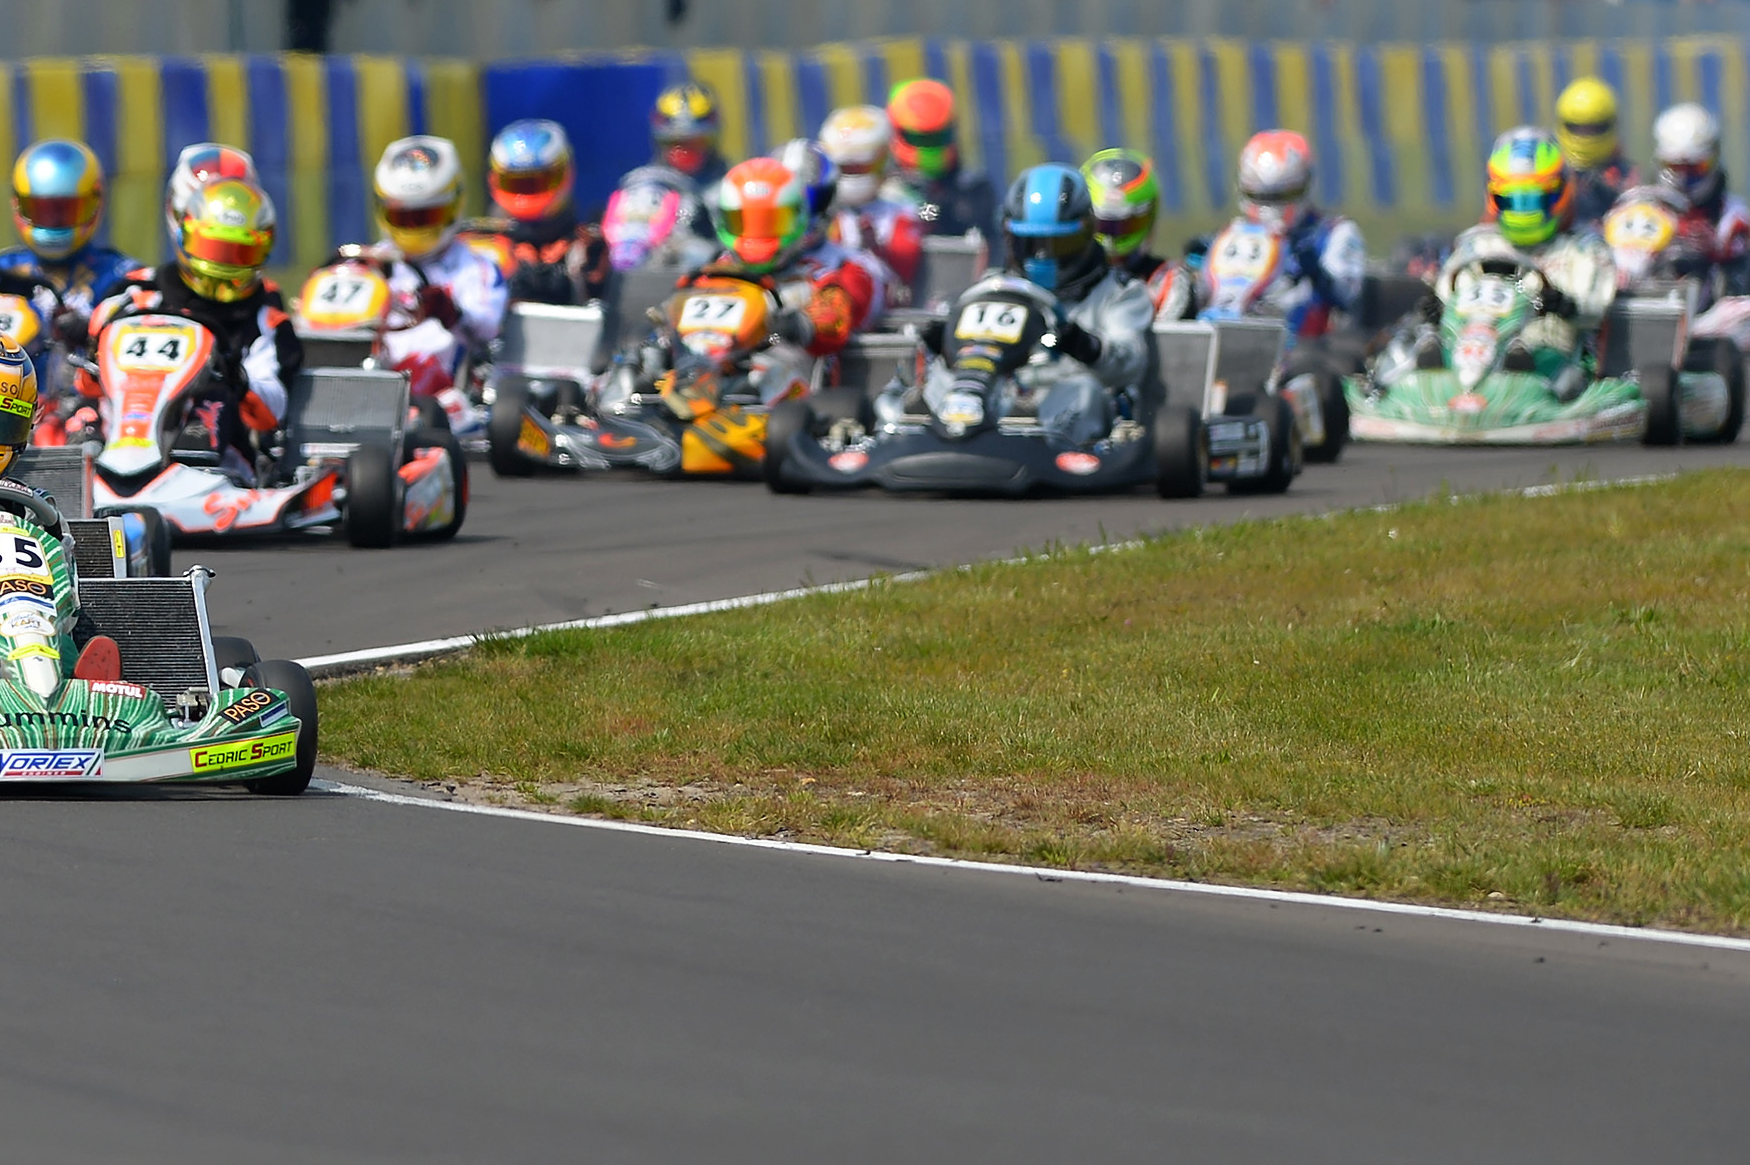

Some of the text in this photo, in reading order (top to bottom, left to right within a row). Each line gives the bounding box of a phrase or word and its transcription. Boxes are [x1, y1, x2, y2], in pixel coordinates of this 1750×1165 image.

[321, 281, 368, 305] 47
[693, 300, 735, 319] 27
[977, 308, 1016, 327] 16
[125, 336, 182, 362] 44
[91, 682, 144, 699] MOTUL
[223, 691, 272, 722] PASO
[0, 750, 93, 771] VORTEX
